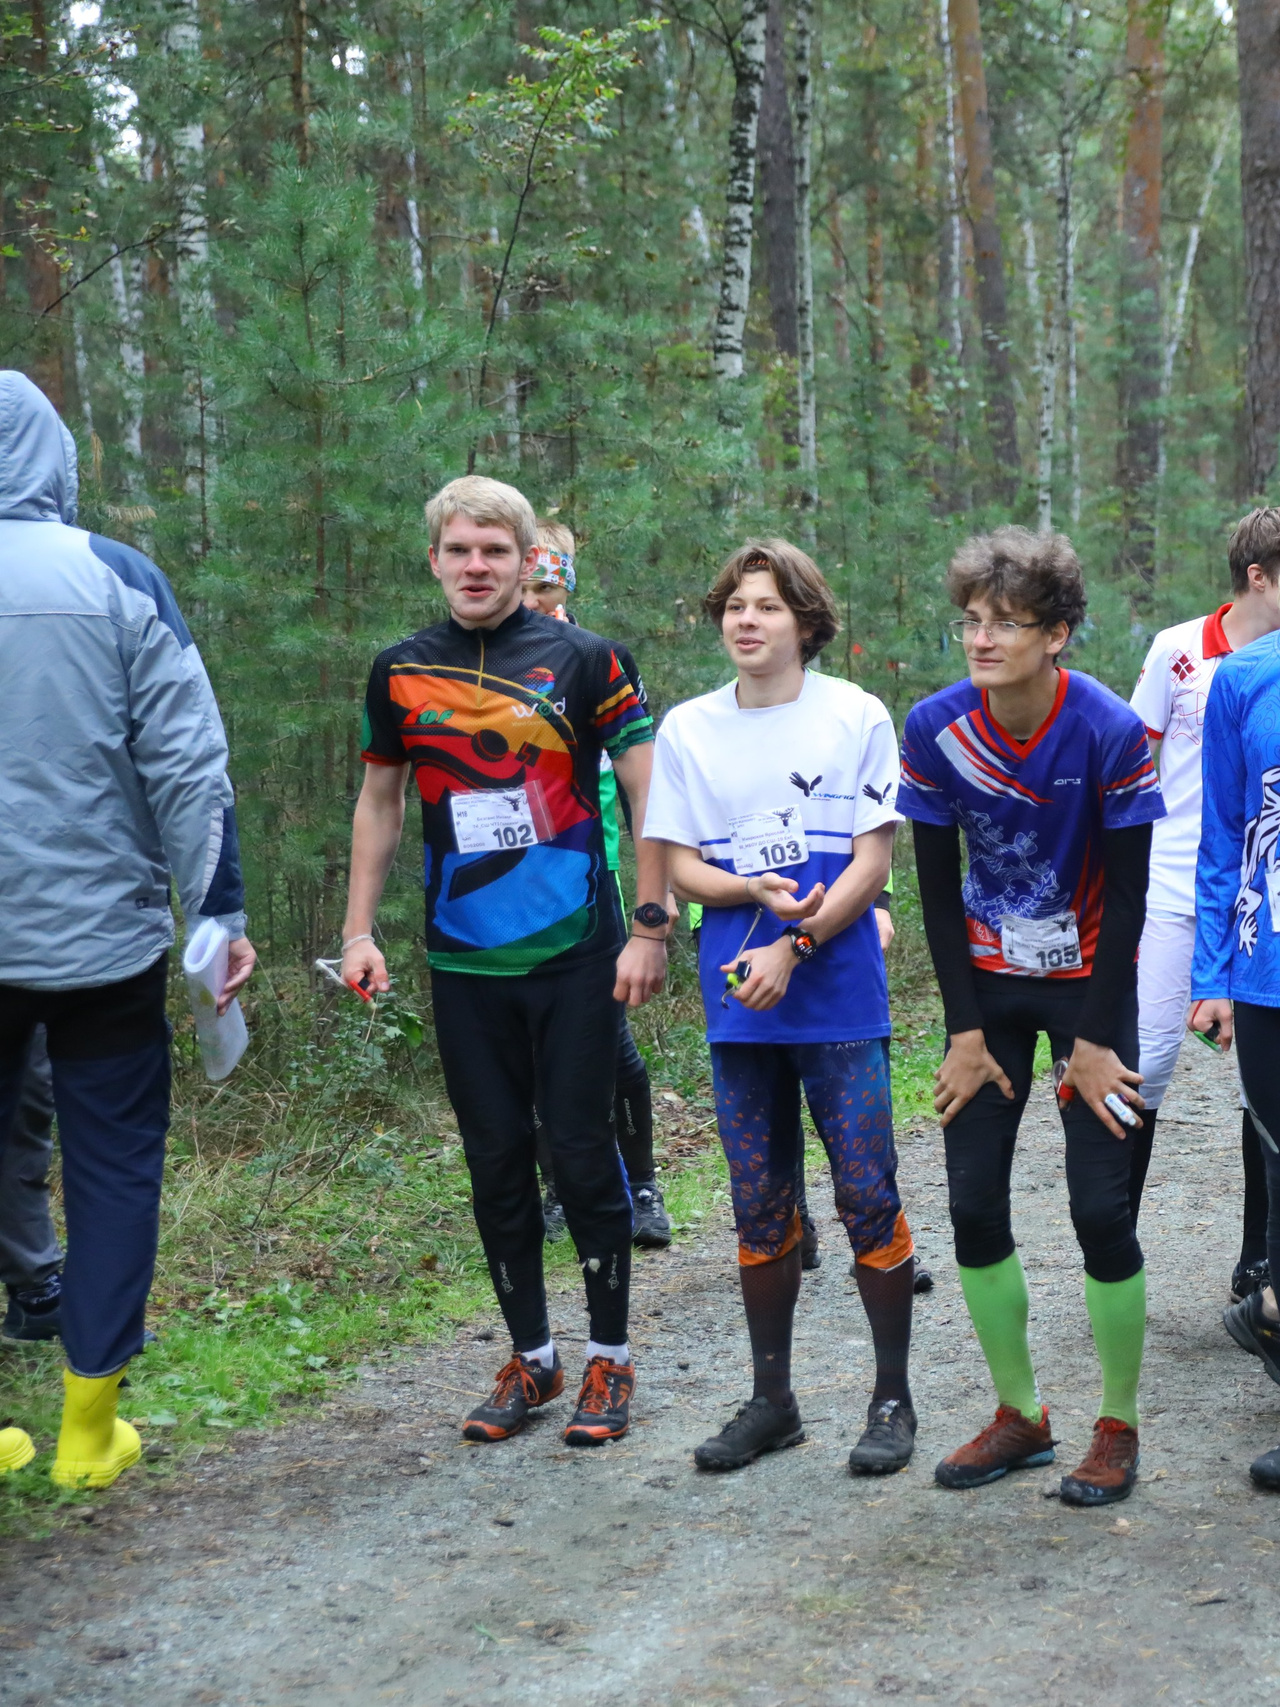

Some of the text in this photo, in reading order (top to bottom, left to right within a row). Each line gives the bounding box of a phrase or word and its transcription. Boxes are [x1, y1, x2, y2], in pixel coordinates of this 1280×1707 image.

[492, 823, 534, 848] 102
[759, 840, 802, 867] 103
[1036, 944, 1079, 968] 105
